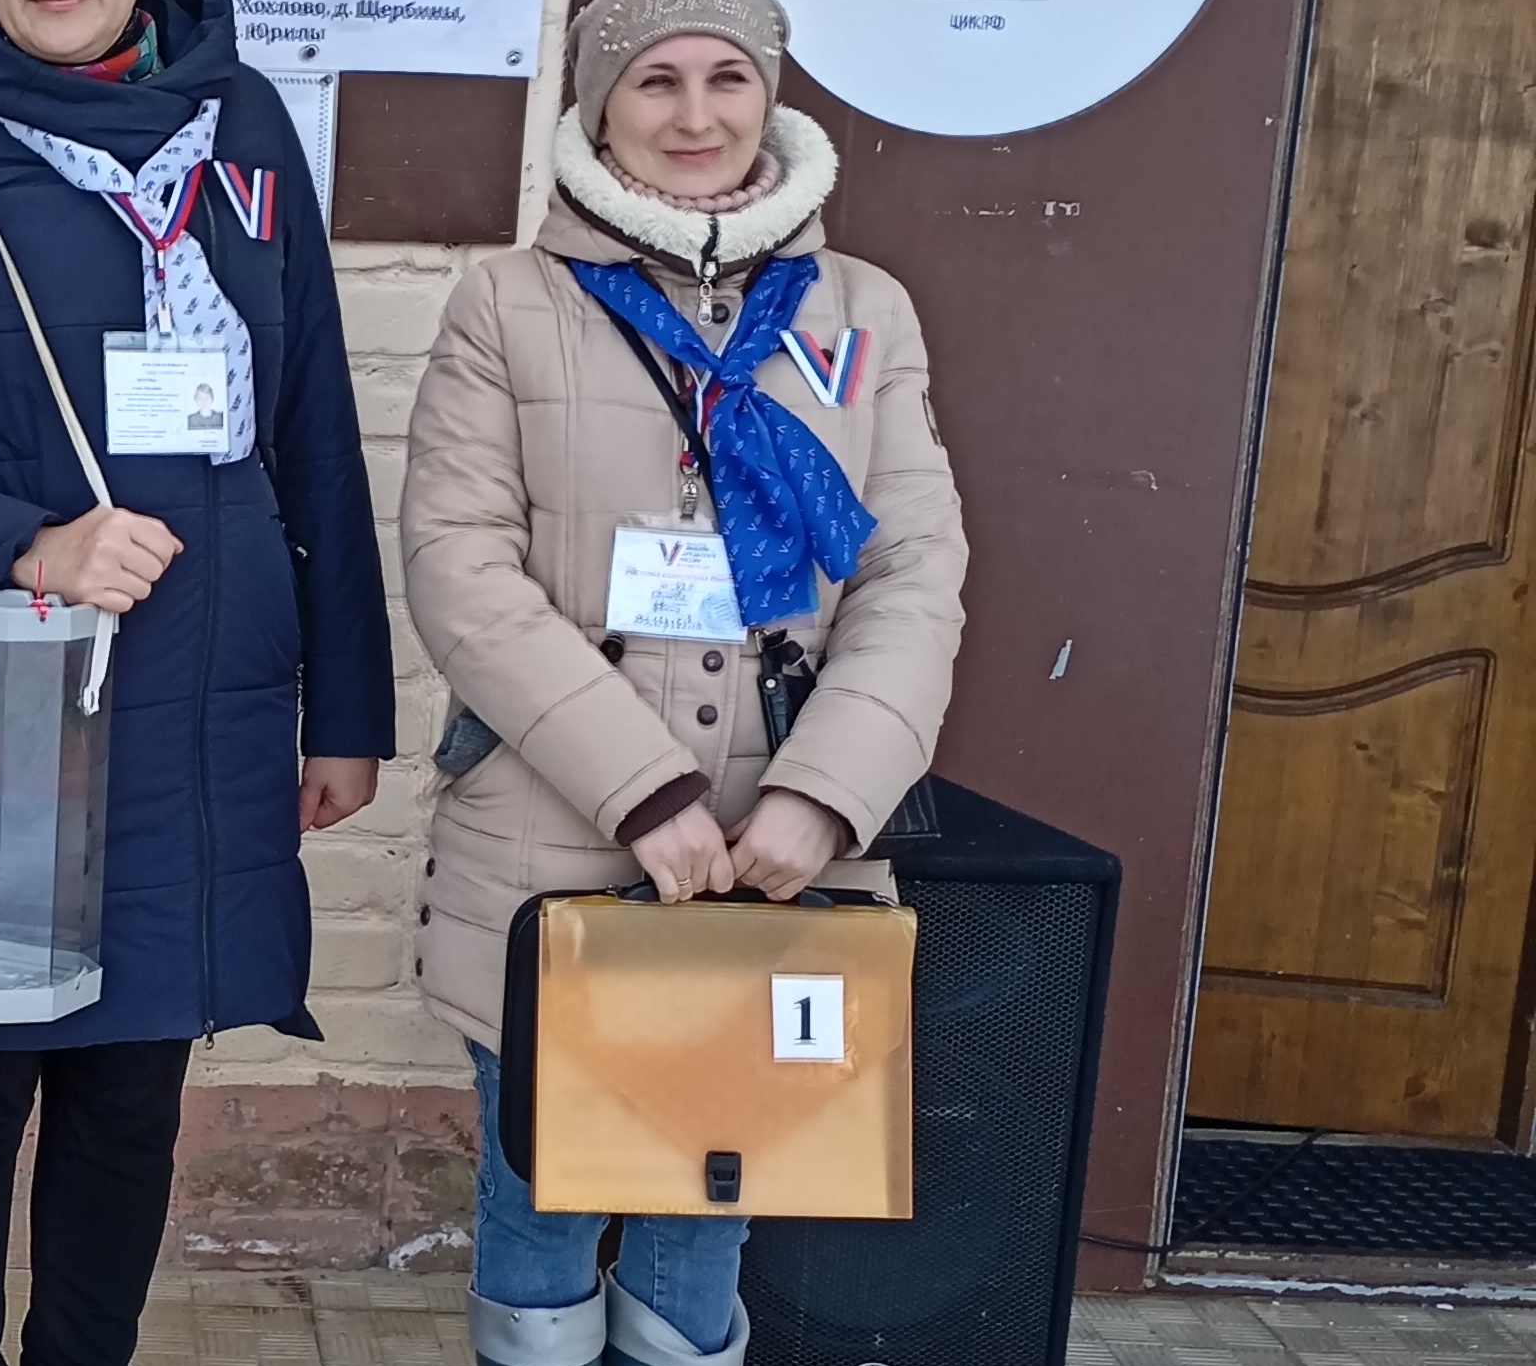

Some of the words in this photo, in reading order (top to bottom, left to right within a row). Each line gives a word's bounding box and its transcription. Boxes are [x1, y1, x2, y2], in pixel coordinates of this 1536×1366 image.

[331, 2, 353, 21] д.
[355, 0, 466, 23] Щербины,
[793, 995, 818, 1046] 1
